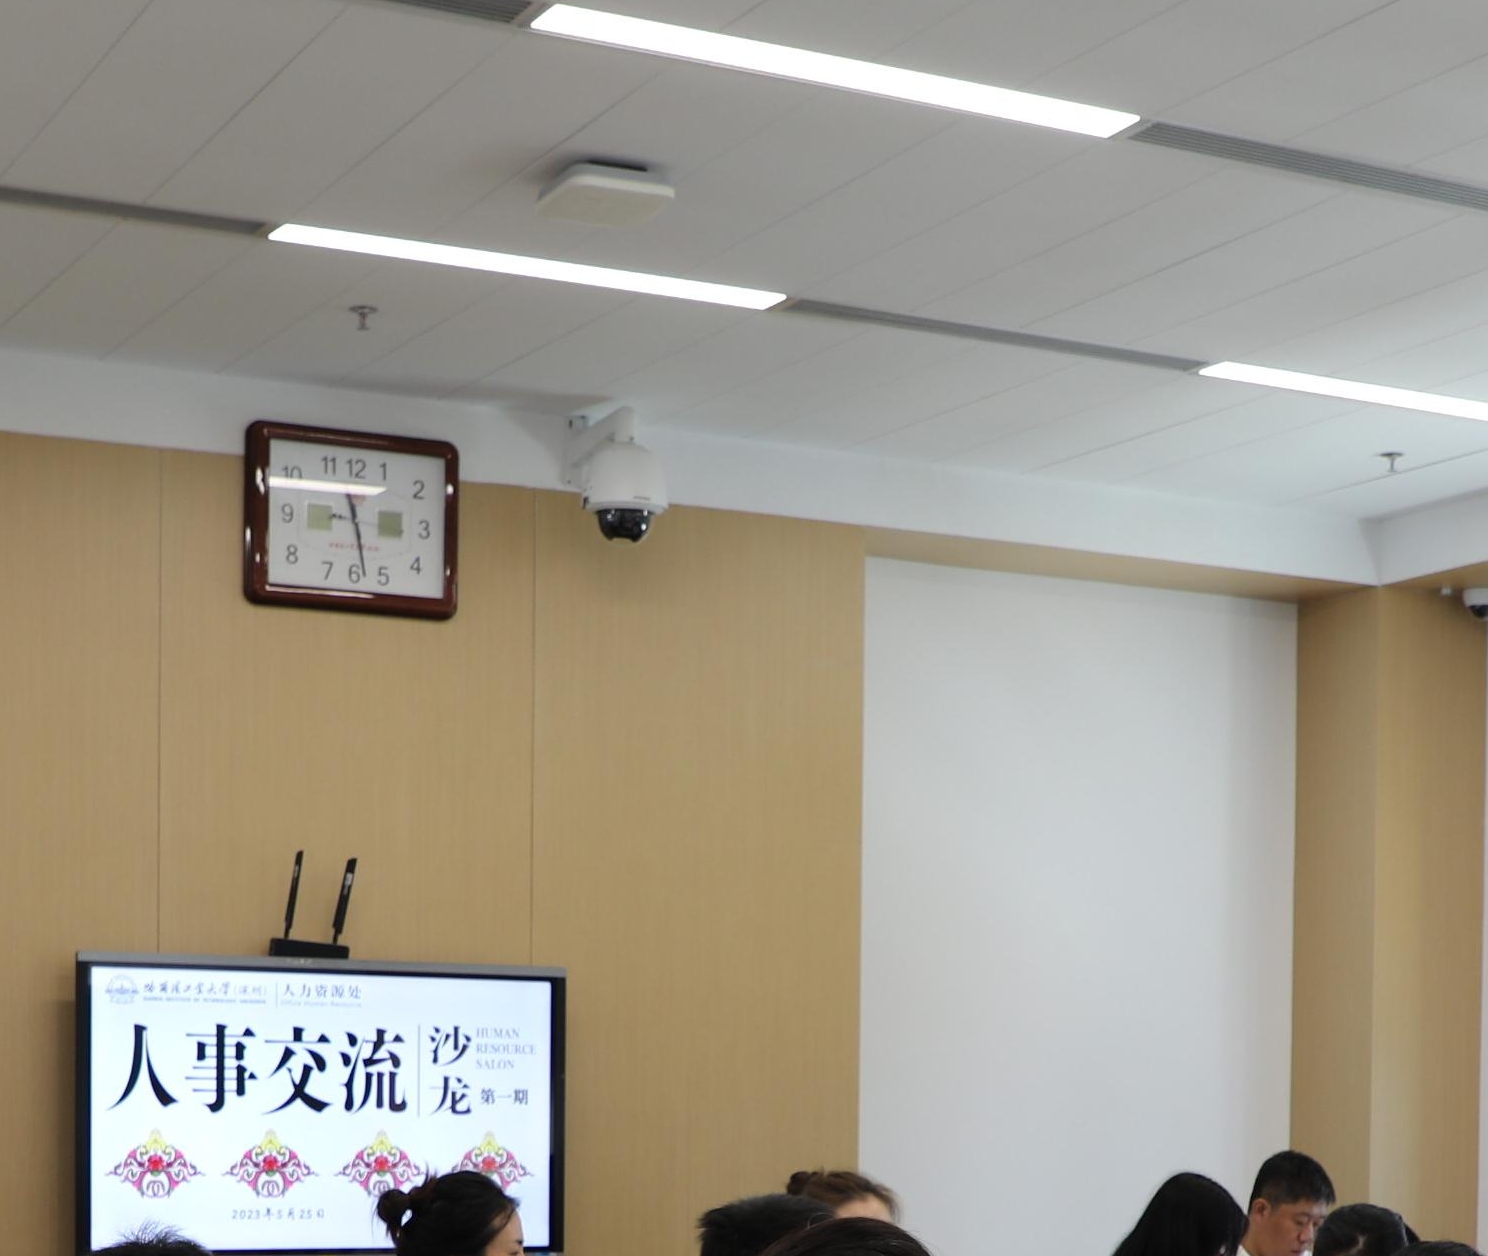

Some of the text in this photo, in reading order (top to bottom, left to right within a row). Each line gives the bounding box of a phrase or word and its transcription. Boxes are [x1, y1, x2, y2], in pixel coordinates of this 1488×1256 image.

[321, 456, 337, 476] 11
[346, 458, 367, 479] 12
[379, 462, 388, 481] 1
[413, 480, 425, 500] 2
[281, 503, 294, 523] 9
[418, 520, 431, 540] 3
[286, 544, 299, 564] 8
[322, 561, 334, 580] 7
[348, 563, 361, 584] 6
[377, 566, 390, 586] 5
[410, 557, 422, 575] 4
[476, 1027, 520, 1040] HUMAN
[476, 1043, 538, 1056] RESOURCE
[107, 1023, 407, 1115] 人事交流
[428, 1025, 473, 1115] 沙龙
[476, 1059, 516, 1070] SALON
[480, 1087, 530, 1106] 第一期
